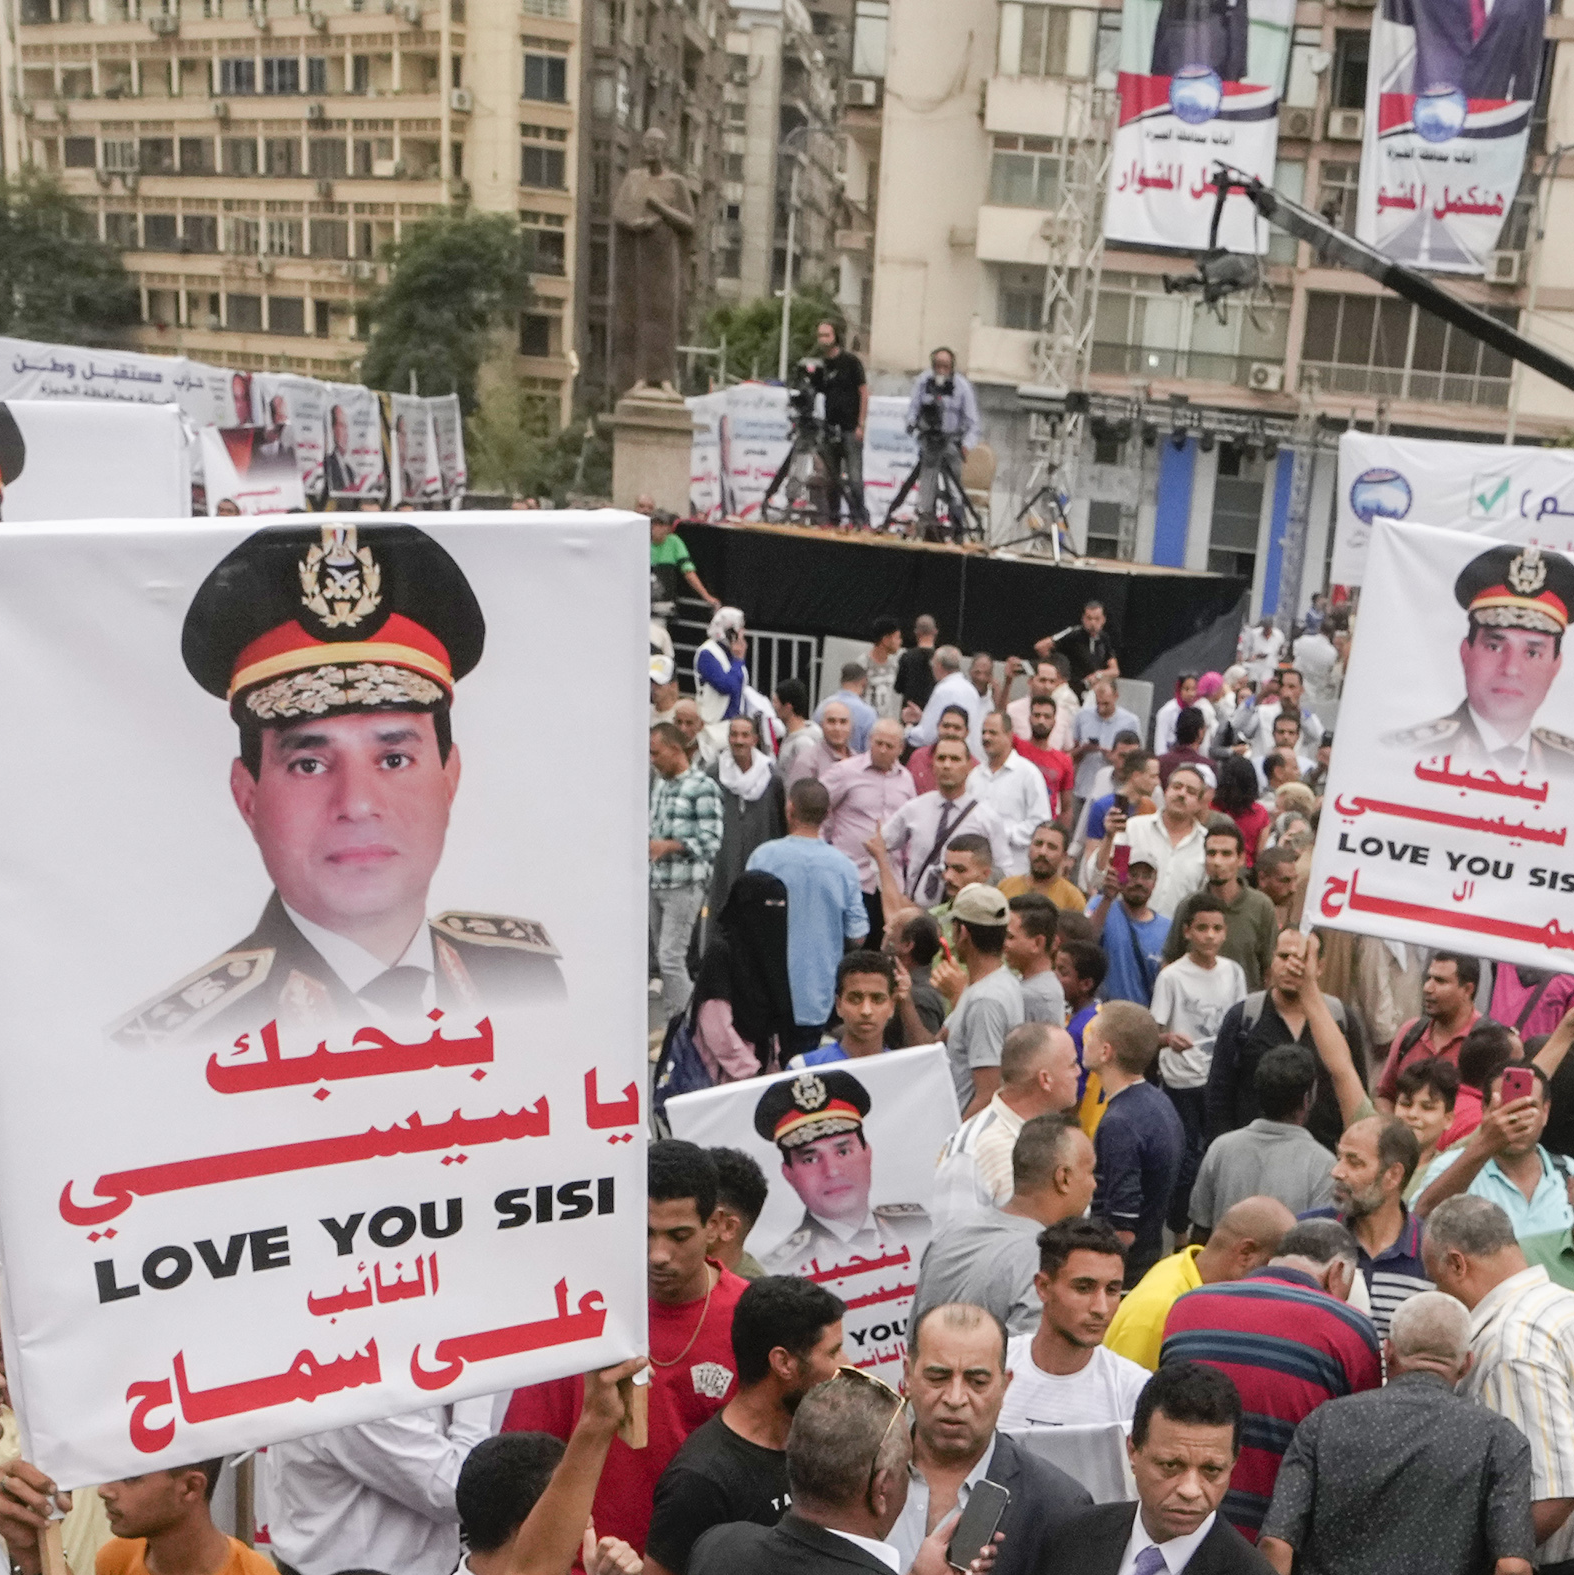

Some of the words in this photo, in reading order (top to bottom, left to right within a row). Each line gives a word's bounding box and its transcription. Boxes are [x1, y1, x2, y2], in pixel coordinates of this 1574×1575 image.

[1377, 180, 1426, 215] المشو
[12, 355, 76, 378] وطن
[81, 361, 163, 384] مستقبل
[1413, 753, 1550, 811] بنحبك
[1333, 792, 1568, 848] سيسي
[1337, 833, 1430, 866] LOVE
[1445, 850, 1515, 881] YOU
[205, 1006, 494, 1102] بنحبك
[583, 1065, 640, 1146] يا
[57, 1093, 551, 1244] سيسي
[93, 1225, 292, 1304] LOVE
[318, 1196, 463, 1258] YOU
[494, 1176, 616, 1231] SISI
[306, 1251, 441, 1325] النائب
[409, 1276, 608, 1392] على
[848, 1317, 909, 1348] YOU
[124, 1335, 383, 1454] سماح
